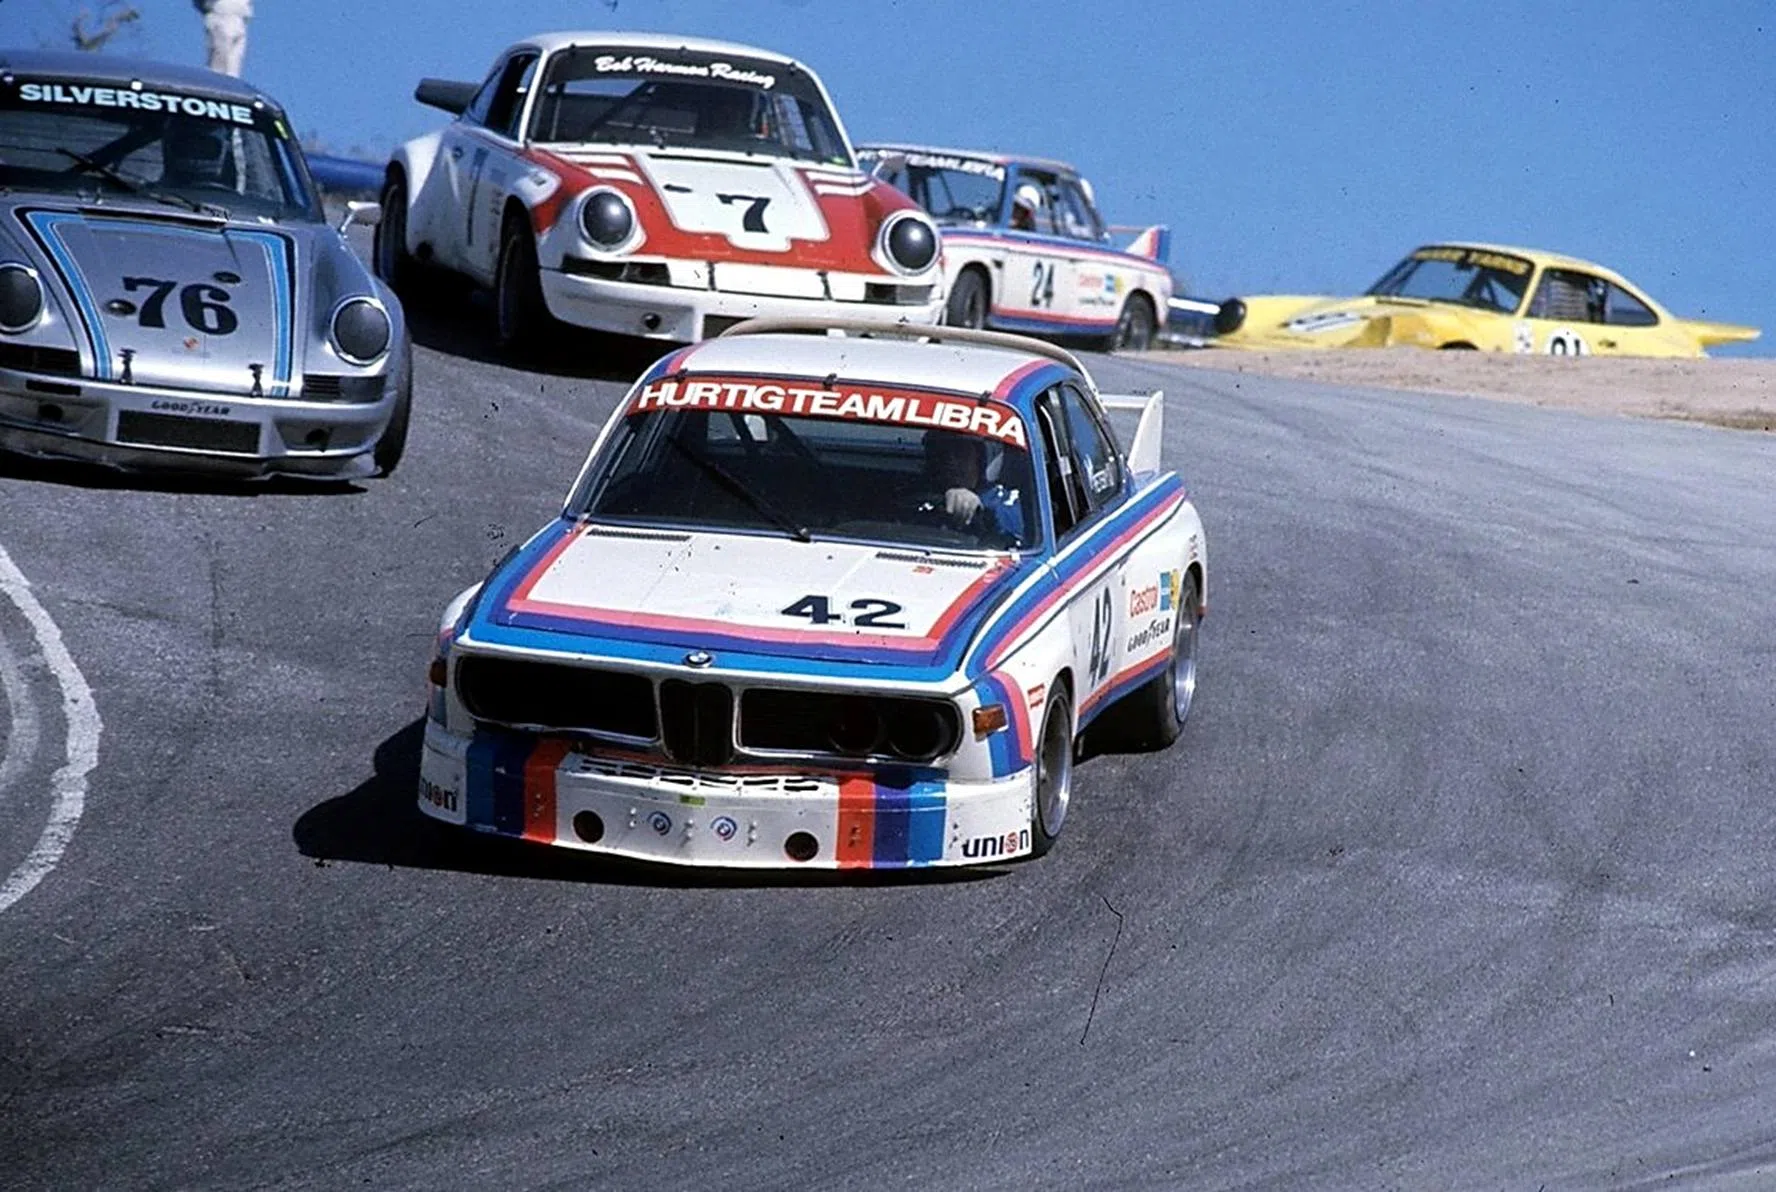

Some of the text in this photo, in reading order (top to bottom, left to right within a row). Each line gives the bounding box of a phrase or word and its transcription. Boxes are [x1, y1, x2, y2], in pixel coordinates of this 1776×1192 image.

[594, 55, 634, 72] Bob
[709, 62, 776, 89] Racing
[19, 83, 254, 124] SILVERSTONE
[715, 193, 772, 234] 7
[121, 276, 239, 336] 76
[1031, 261, 1055, 308] 24
[638, 381, 1026, 447] HURTIG TEAM LIBRA
[780, 595, 906, 630] 42
[1089, 586, 1113, 690] 42
